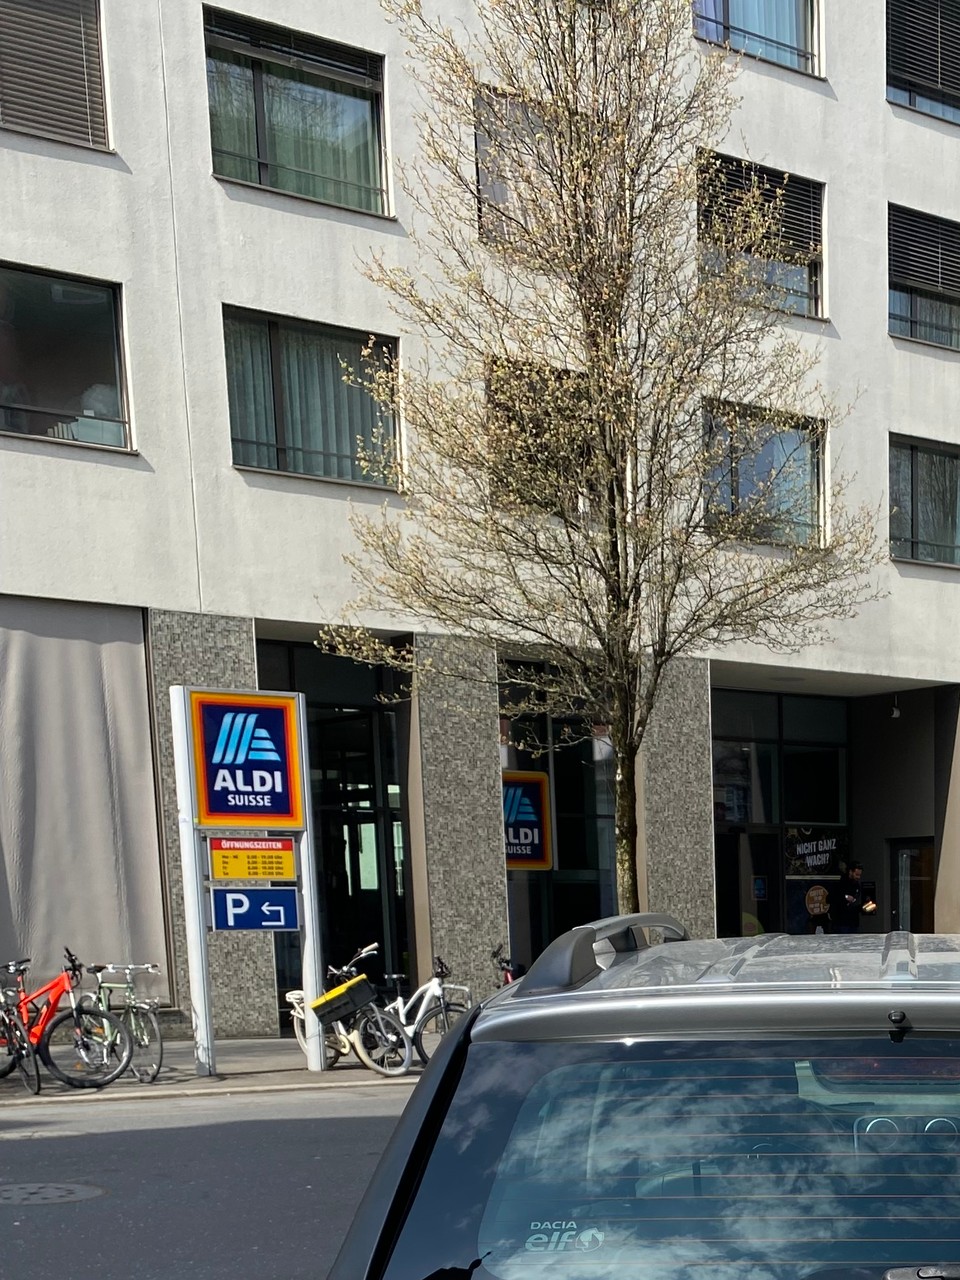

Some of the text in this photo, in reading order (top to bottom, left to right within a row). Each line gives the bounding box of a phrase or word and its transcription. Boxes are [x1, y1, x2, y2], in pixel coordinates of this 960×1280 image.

[213, 769, 283, 793] ALDI
[227, 794, 272, 806] SUISSE
[221, 839, 282, 849] ÖFFNUNGSZEITEN
[504, 827, 539, 844] LDI
[796, 838, 837, 855] NICHT GANZ
[806, 853, 830, 867] WACH?
[226, 893, 249, 926] P
[530, 1221, 577, 1229] DACIA
[524, 1230, 577, 1251] elf
